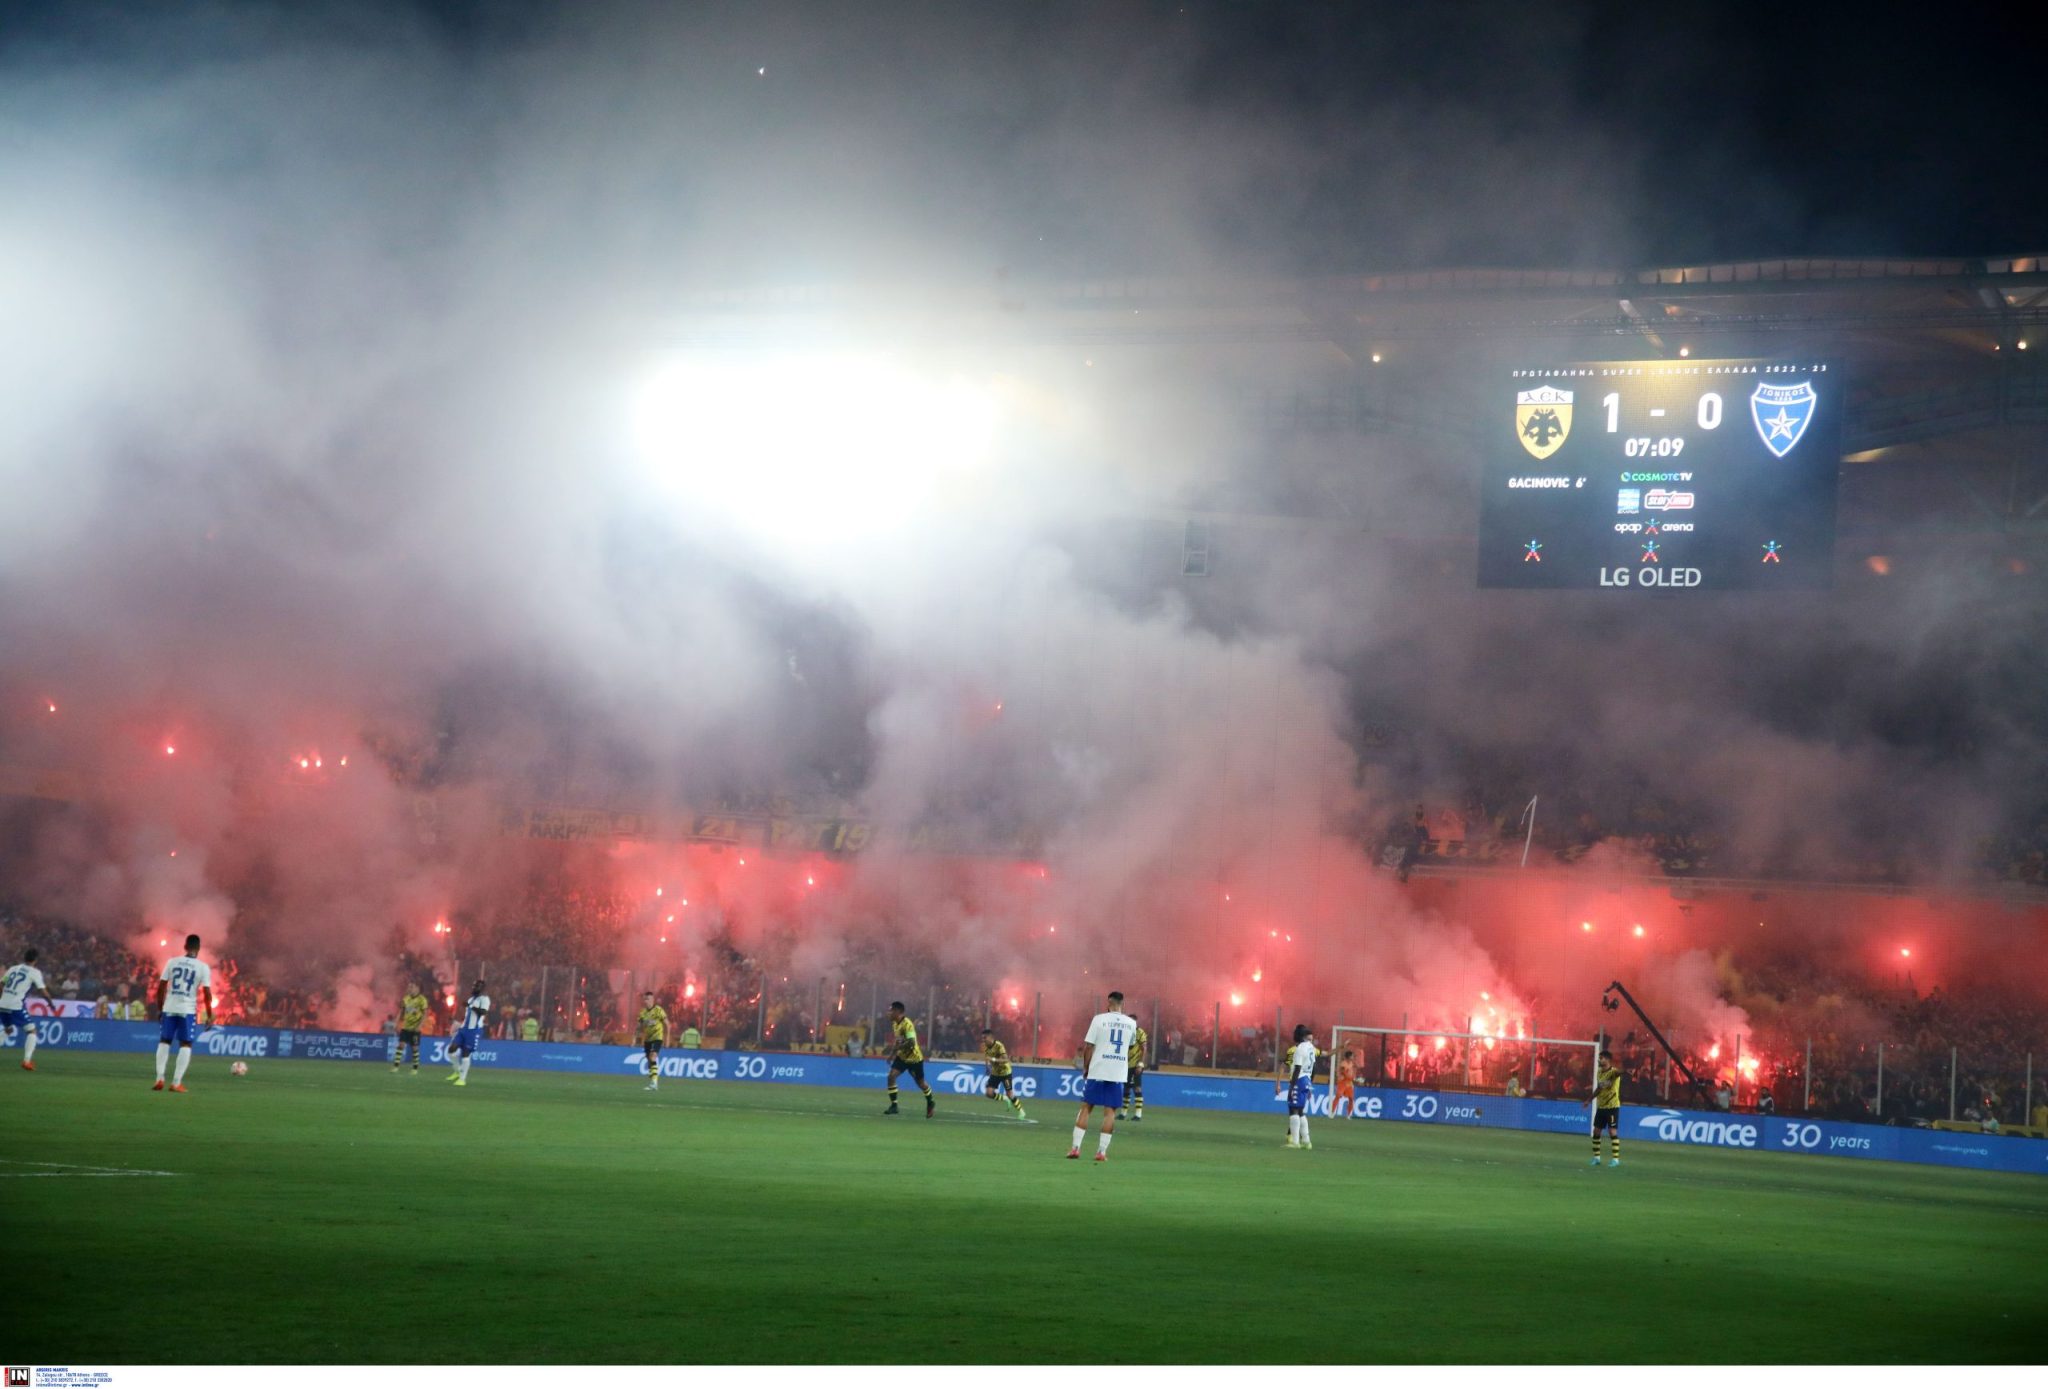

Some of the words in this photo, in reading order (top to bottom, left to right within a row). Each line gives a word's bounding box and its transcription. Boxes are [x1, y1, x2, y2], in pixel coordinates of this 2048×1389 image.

[1765, 364, 1797, 373] 2022
[1812, 364, 1828, 372] 23
[1602, 392, 1620, 433] 1
[1697, 391, 1723, 430] 0
[1625, 438, 1685, 457] 07:09
[1508, 477, 1570, 489] GACINOVIC
[1614, 523, 1642, 534] opap
[1661, 523, 1694, 532] arena
[1600, 567, 1630, 587] LG
[1638, 567, 1702, 587] OLED
[6, 971, 27, 991] 87
[171, 967, 196, 992] 24
[37, 1020, 63, 1045] 30
[66, 1031, 95, 1045] years
[294, 1034, 329, 1045] SUPER
[330, 1035, 384, 1049] LEAGUE
[1109, 1028, 1124, 1054] 4
[209, 1032, 268, 1056] avance
[472, 1051, 498, 1062] ears
[734, 1056, 766, 1078] 30
[771, 1065, 804, 1079] years
[1402, 1094, 1438, 1118] 30
[1659, 1117, 1757, 1147] avance
[1782, 1123, 1822, 1148] 30
[1829, 1135, 1871, 1150] years
